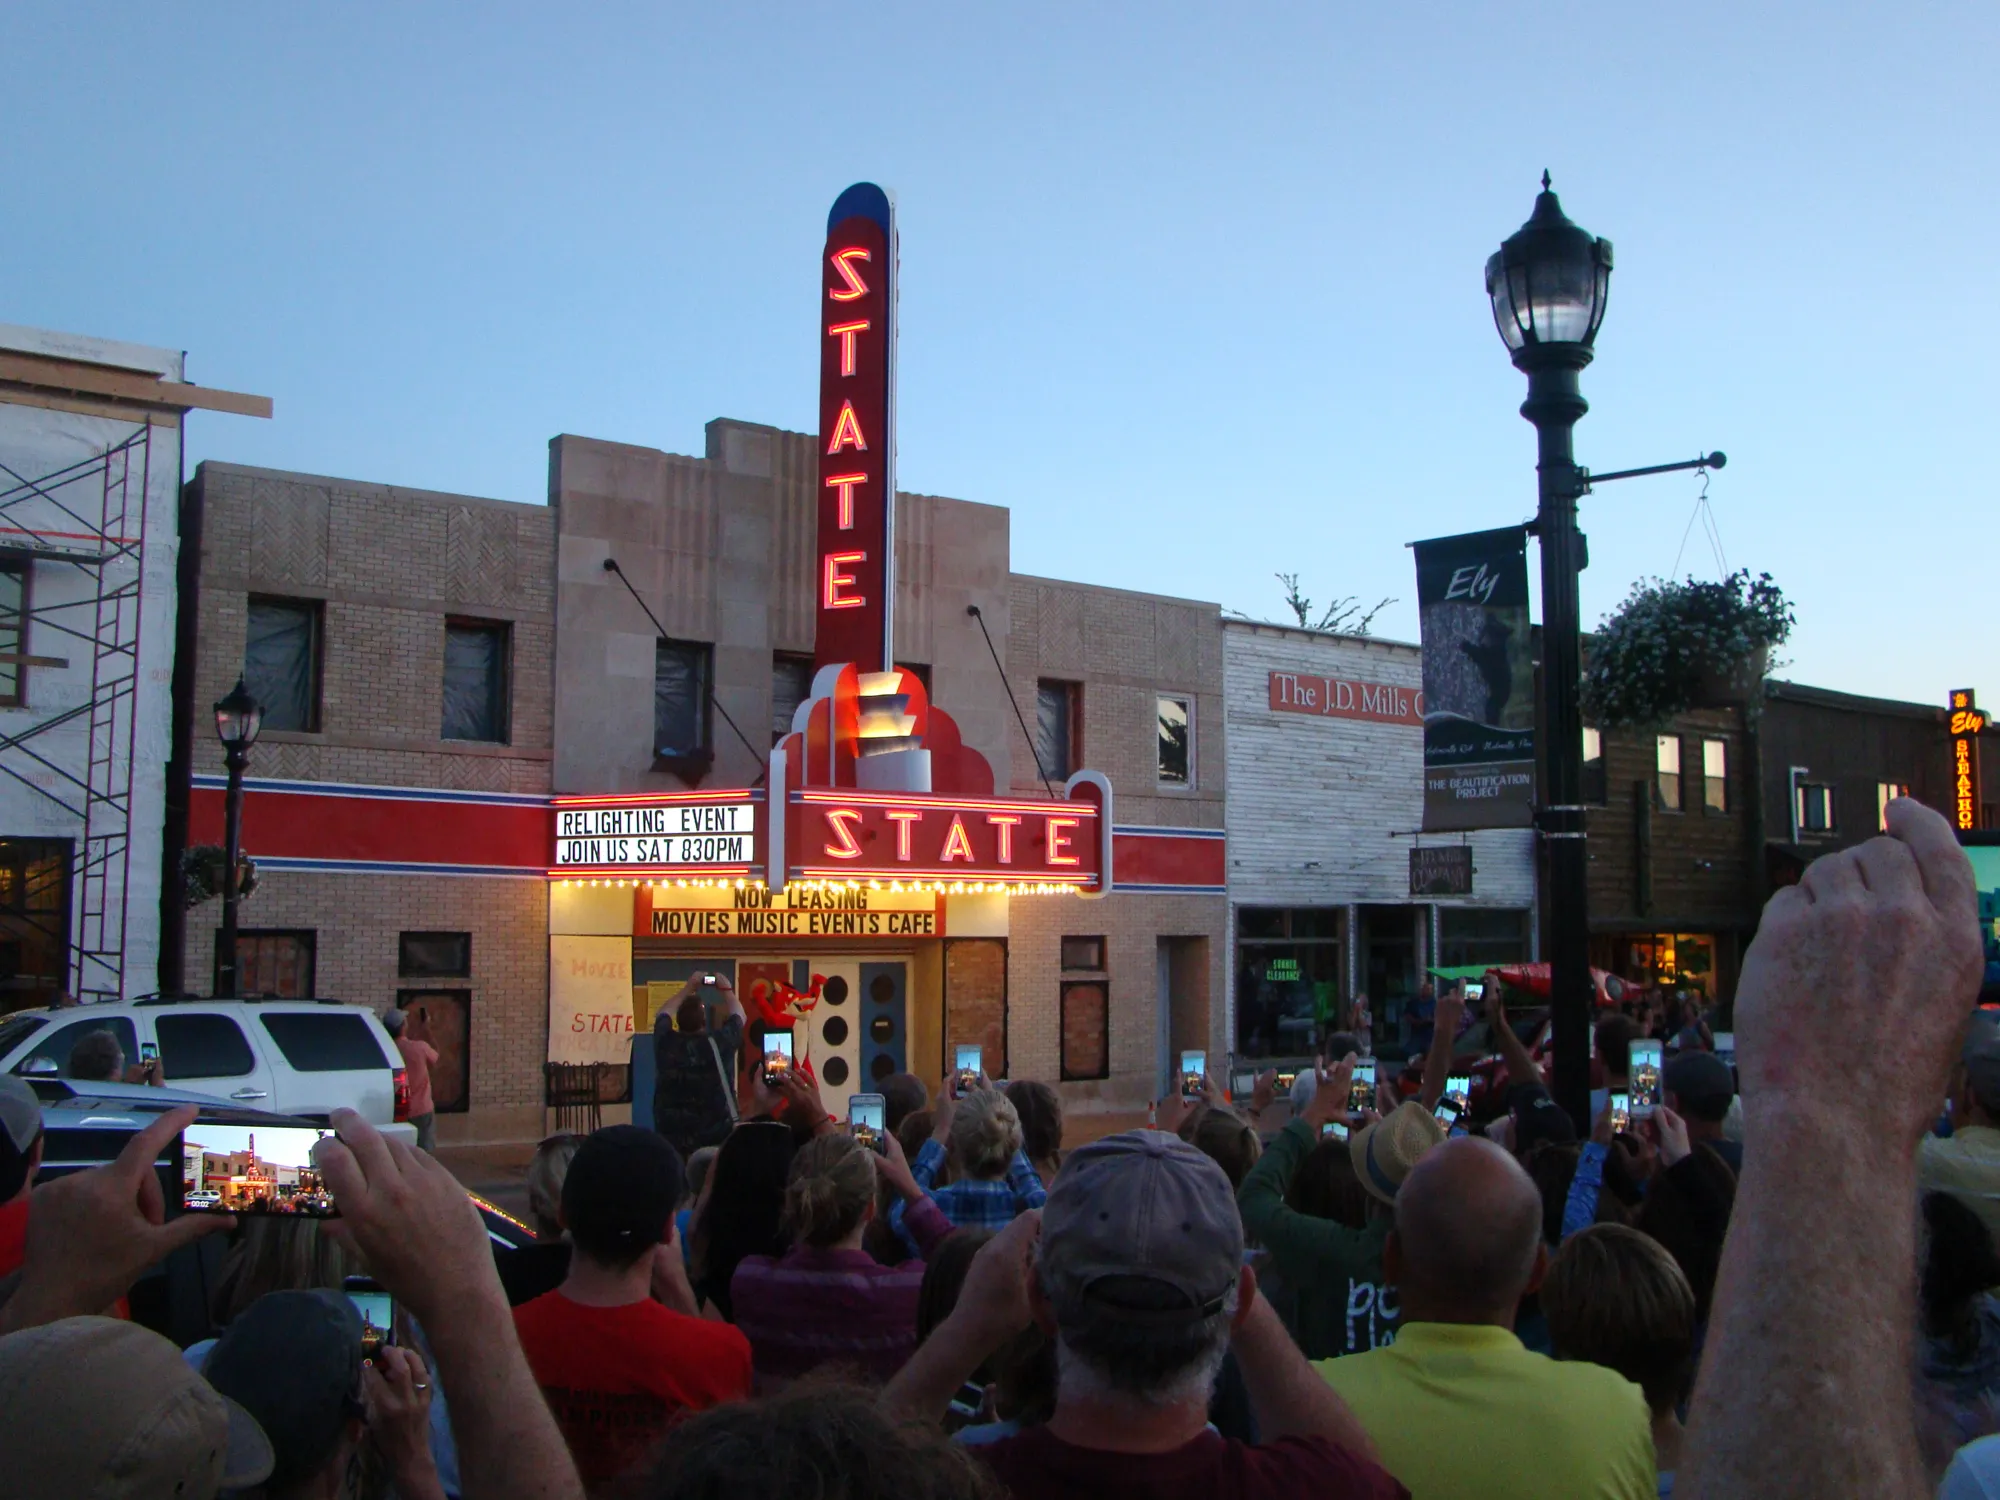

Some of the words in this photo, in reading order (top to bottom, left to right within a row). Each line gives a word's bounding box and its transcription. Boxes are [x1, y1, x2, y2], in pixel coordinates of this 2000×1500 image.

[824, 248, 871, 609] STATE
[1444, 563, 1500, 604] Ely
[1275, 673, 1316, 706] The
[1323, 679, 1356, 713] J.D.
[1361, 684, 1408, 717] Mills
[1951, 711, 1984, 734] Ely
[1428, 780, 1446, 791] THE
[1449, 774, 1530, 789] BEAUTIFICATION
[1456, 786, 1499, 799] PROJECT
[563, 810, 665, 835] RELIGHTING
[681, 807, 738, 832] EVENT
[824, 808, 1080, 866] STATE
[562, 840, 601, 864] JOIN
[607, 839, 628, 862] US
[637, 838, 673, 862] SAT
[681, 837, 743, 862] 830PM
[734, 888, 773, 910] NOW
[787, 887, 868, 911] LEASING
[652, 911, 730, 935] MOVIES
[737, 912, 798, 935] MUSIC
[809, 913, 880, 935] EVENTS
[888, 913, 933, 934] CAFE
[571, 1013, 634, 1034] STATE
